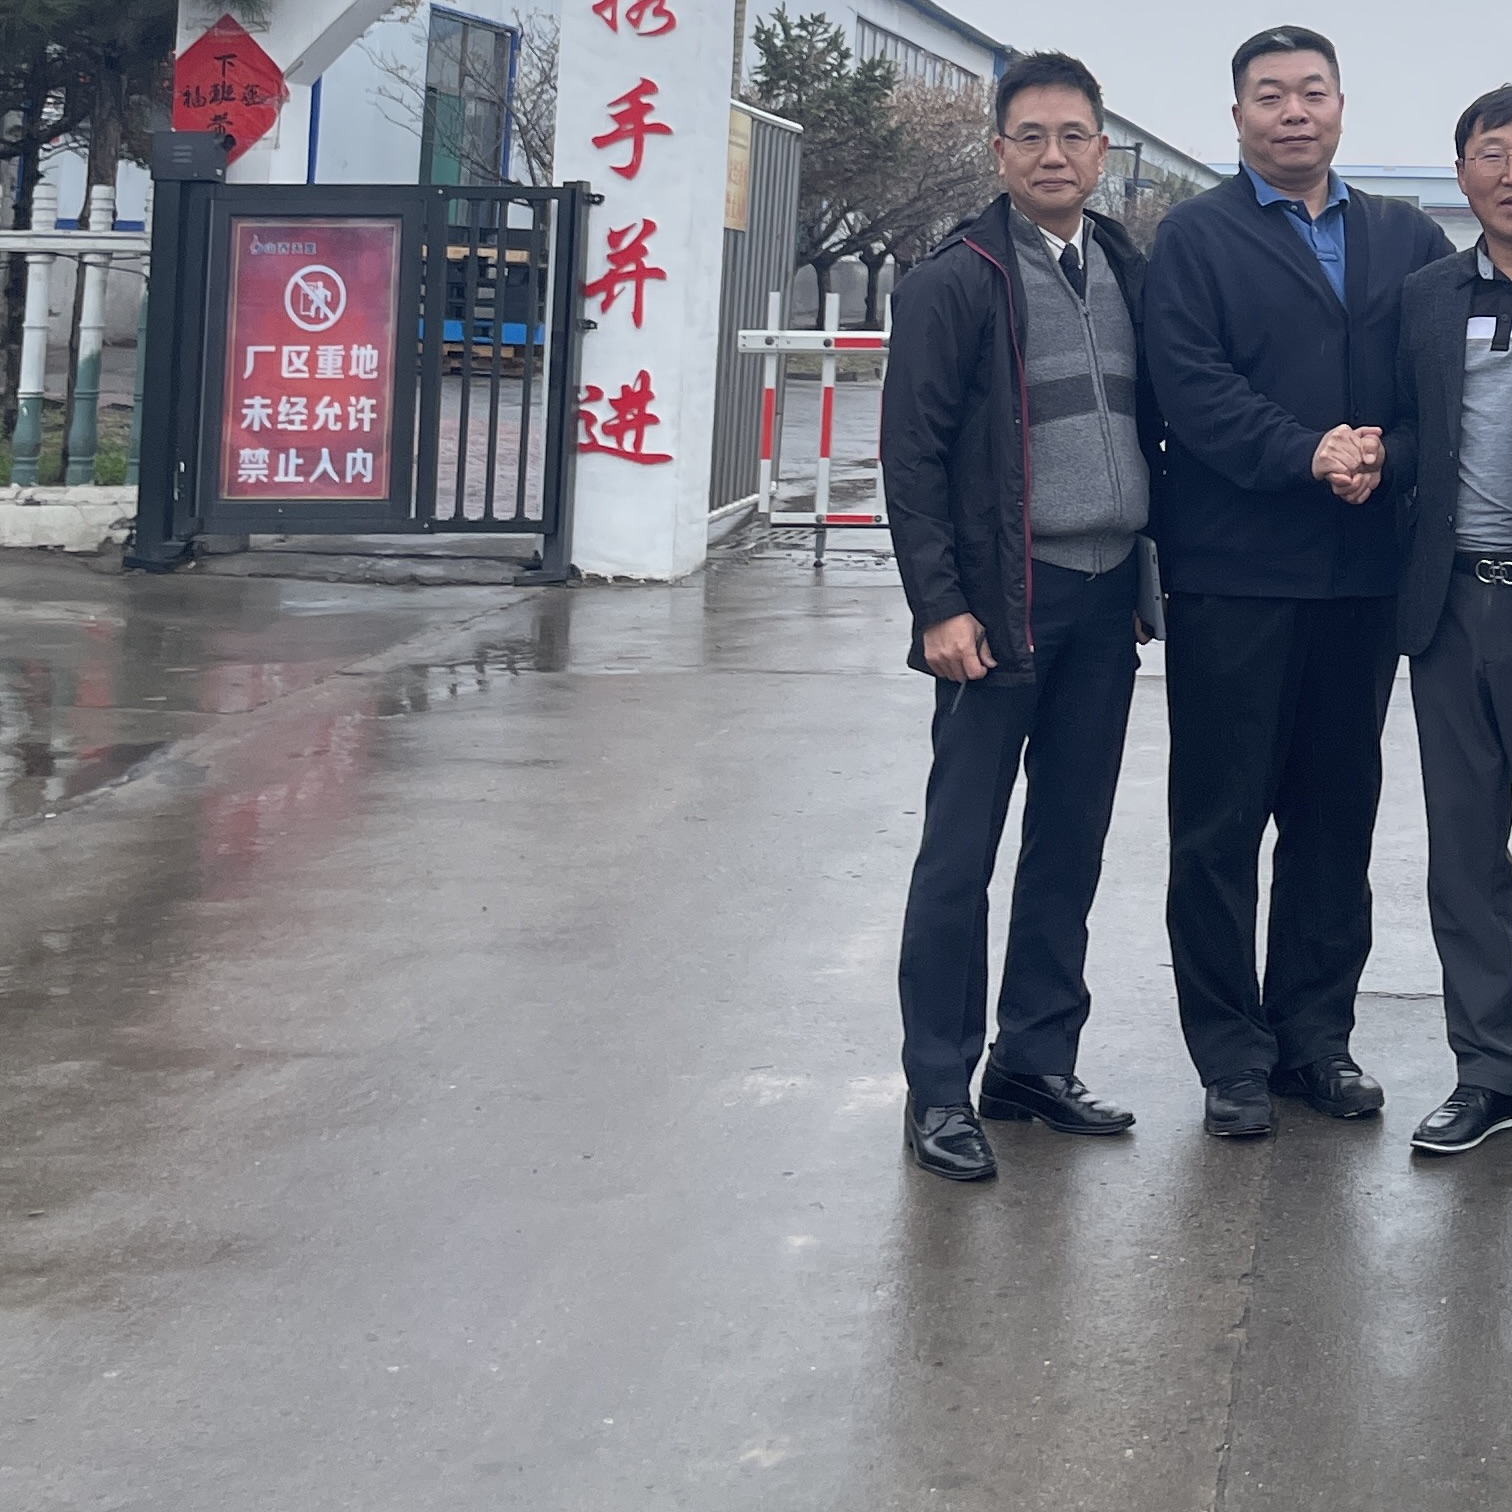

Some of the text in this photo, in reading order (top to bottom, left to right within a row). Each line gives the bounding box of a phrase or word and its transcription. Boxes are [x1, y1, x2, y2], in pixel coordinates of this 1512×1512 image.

[243, 343, 379, 380] 厂区重地
[240, 395, 378, 432] 未经允许
